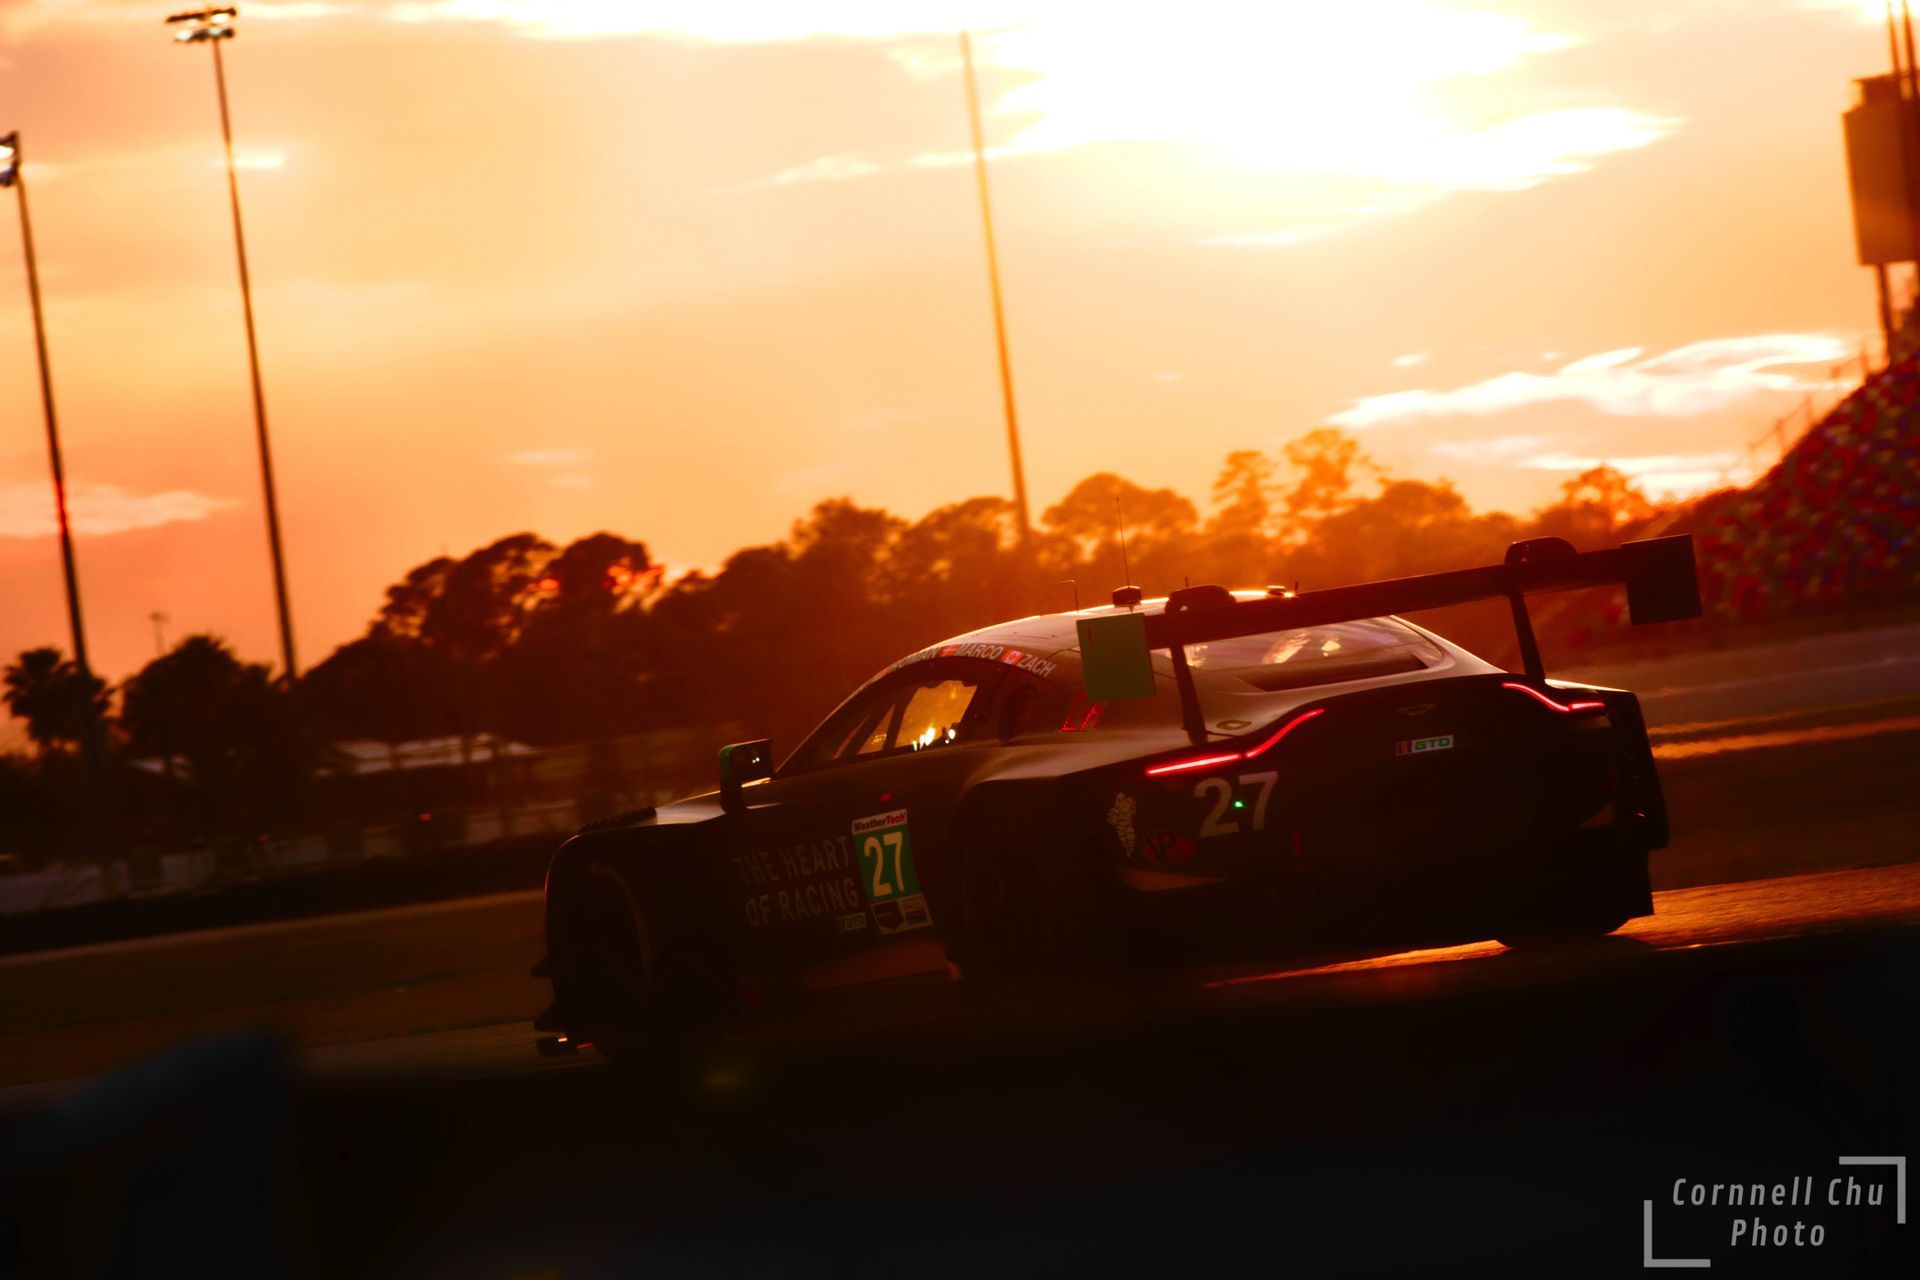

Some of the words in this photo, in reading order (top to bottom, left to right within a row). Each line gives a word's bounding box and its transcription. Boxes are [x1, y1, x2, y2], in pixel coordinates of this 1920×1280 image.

[954, 643, 1004, 660] MARCO
[1017, 653, 1057, 677] ZACH
[1415, 737, 1450, 750] GTD
[853, 811, 906, 833] WeatherTech
[1193, 770, 1279, 838] 27
[732, 851, 780, 886] THE
[777, 836, 849, 880] HEART
[863, 832, 905, 898] 27
[745, 893, 771, 929] OF
[778, 877, 860, 921] RACING
